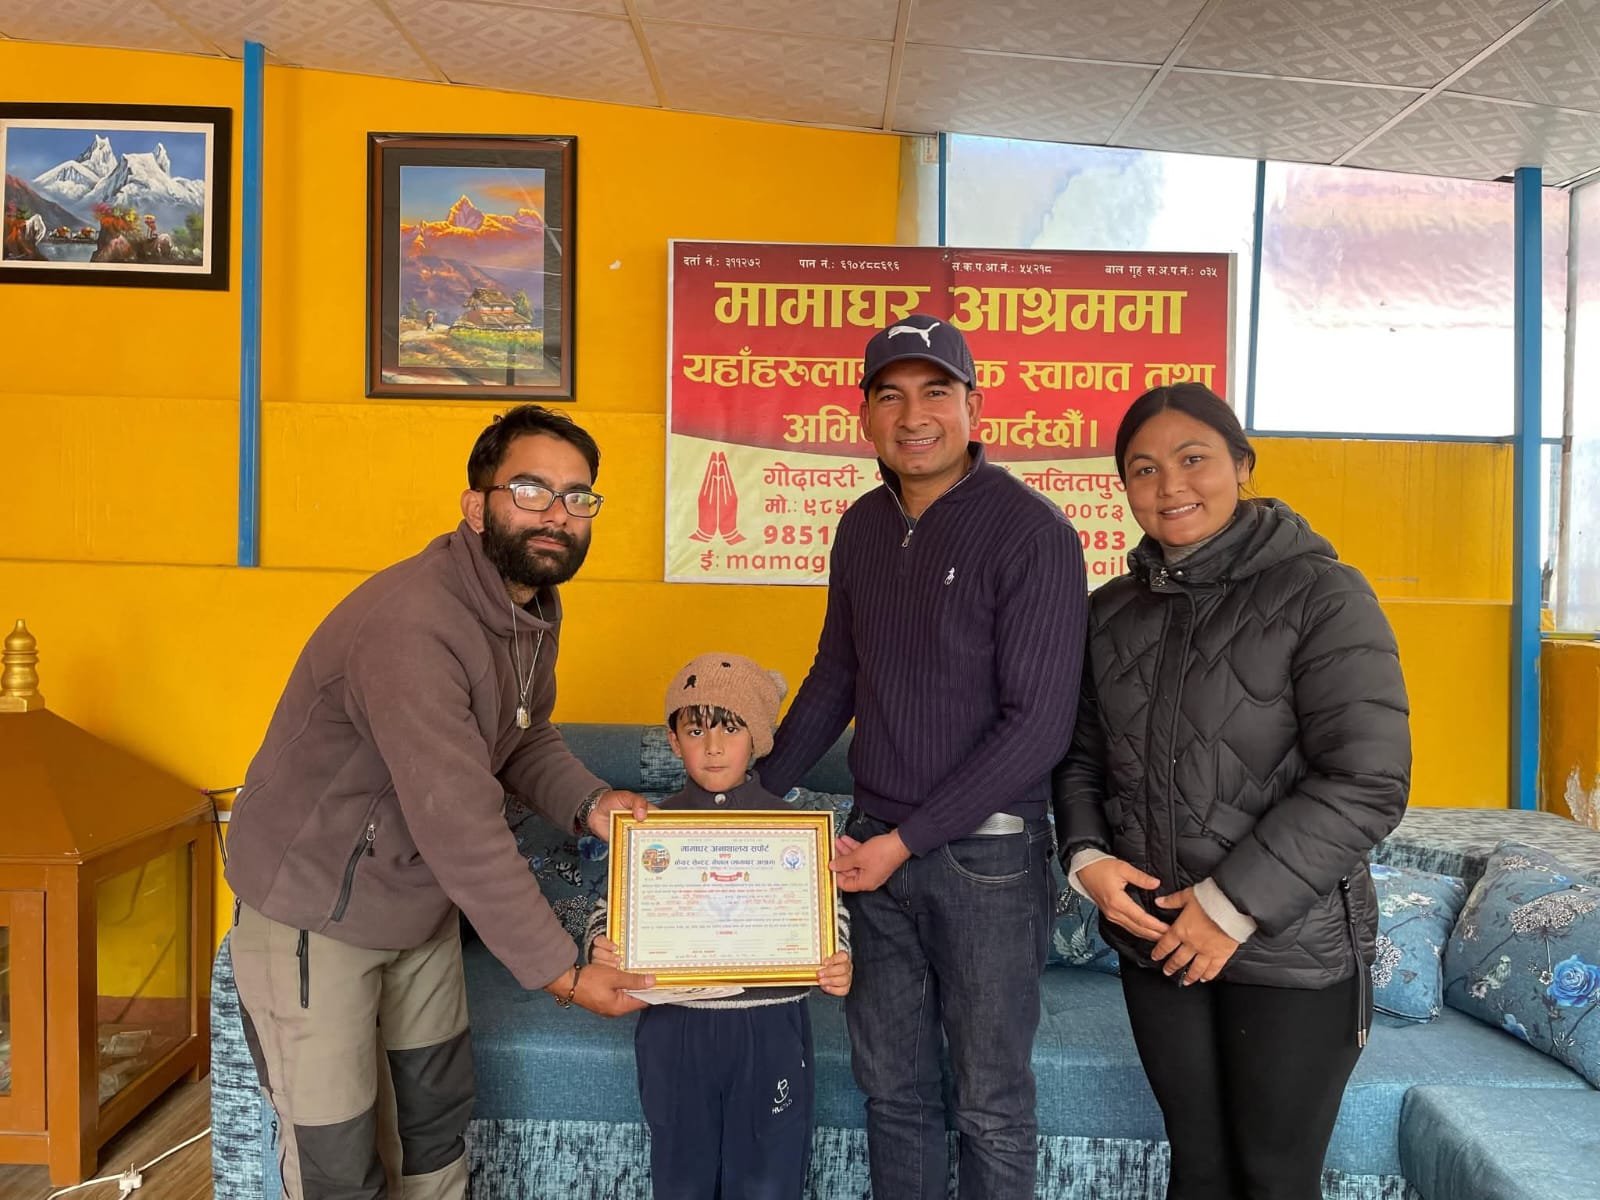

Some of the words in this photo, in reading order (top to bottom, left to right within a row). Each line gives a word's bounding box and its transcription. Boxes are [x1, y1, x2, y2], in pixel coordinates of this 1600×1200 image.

[725, 257, 761, 268] ३११२७२
[799, 259, 816, 269] पान
[1020, 264, 1052, 274] ५५२१८
[1104, 265, 1124, 275] बाल
[1200, 267, 1218, 278] ०३५
[714, 282, 931, 328] मामाघर
[948, 286, 1188, 335] आश्रममा
[1019, 361, 1133, 392] स्वागत
[803, 498, 849, 516] ९८५
[1065, 503, 1124, 522] ००८३
[764, 525, 829, 545] 9851
[1078, 530, 1126, 550] 083
[727, 554, 826, 573] mamag
